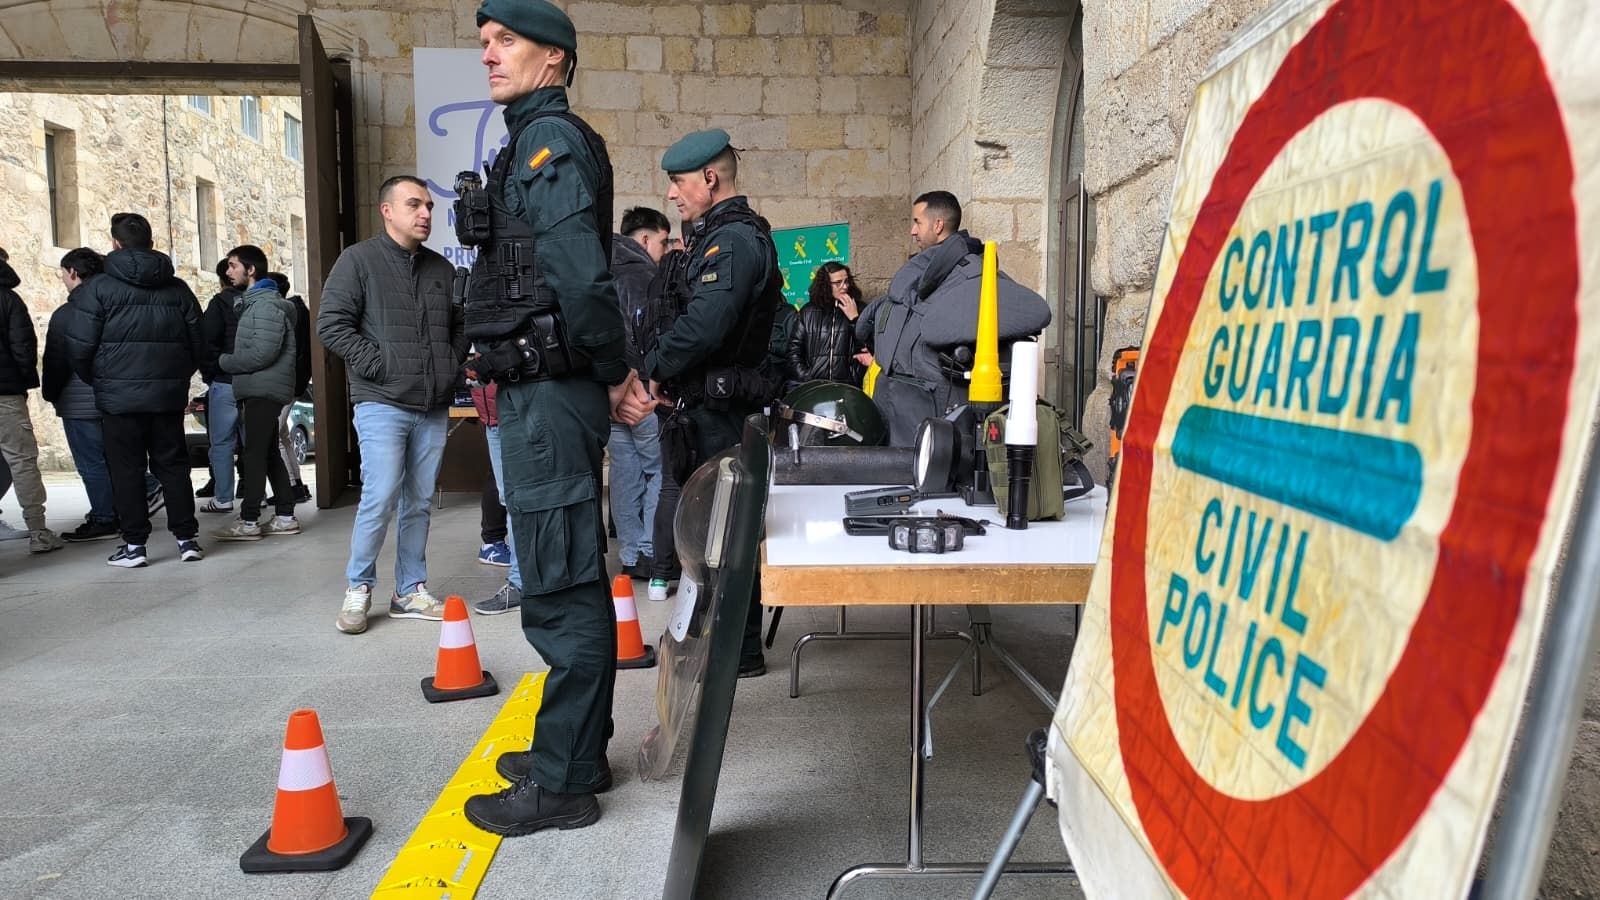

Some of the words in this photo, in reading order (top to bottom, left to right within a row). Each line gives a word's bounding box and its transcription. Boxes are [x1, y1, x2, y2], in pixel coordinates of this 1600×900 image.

[1219, 178, 1449, 312] CONTROL
[1203, 312, 1421, 424] GUARDIA
[1195, 497, 1310, 636] CIVIL
[1156, 572, 1328, 770] POLICE
